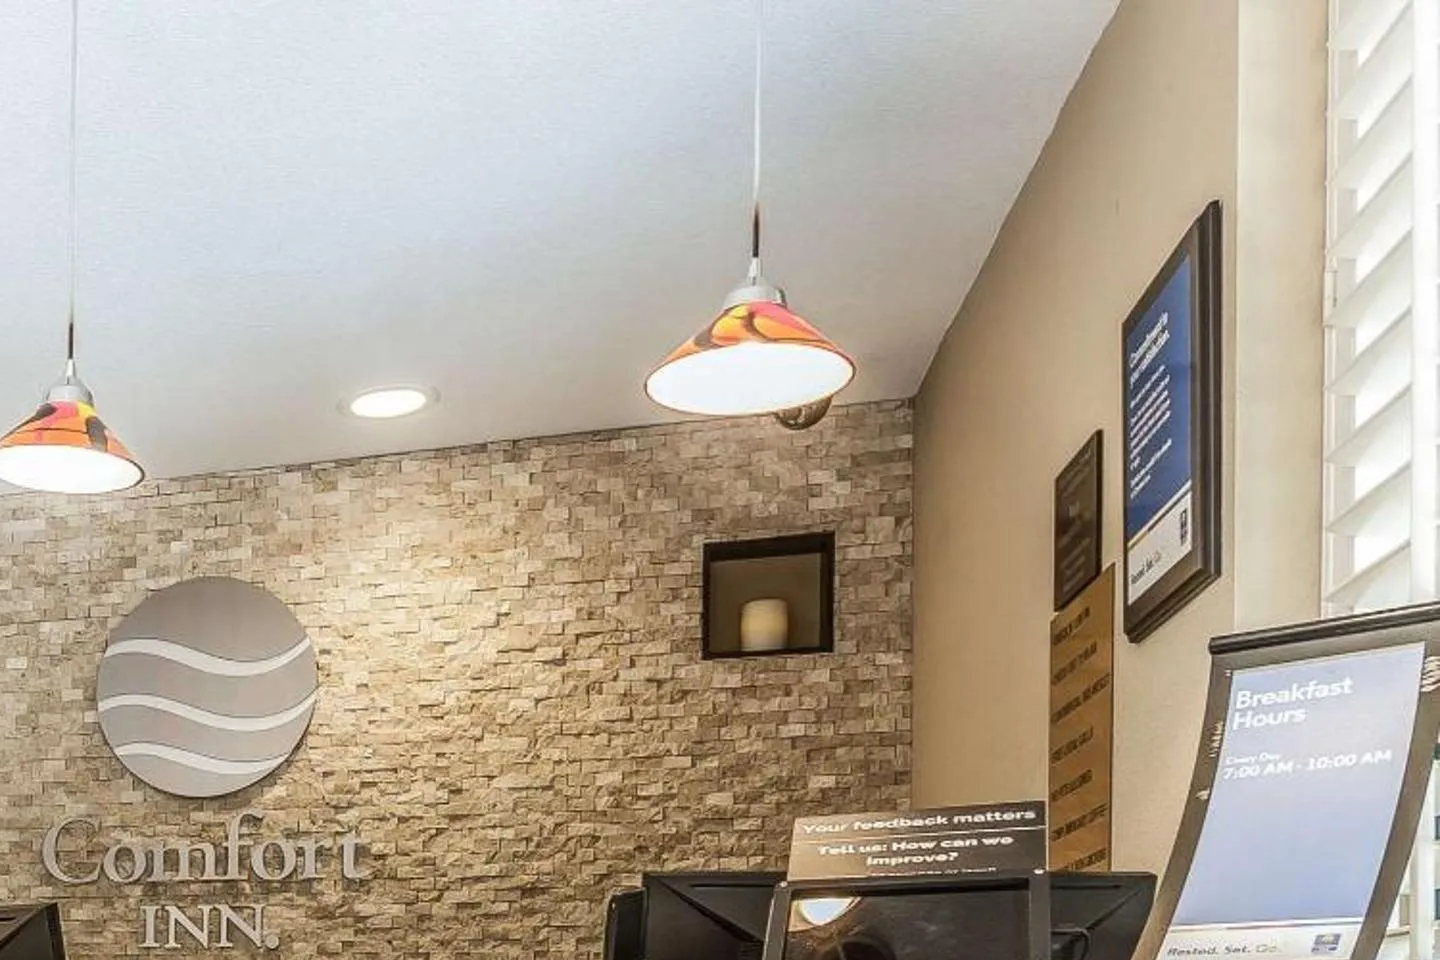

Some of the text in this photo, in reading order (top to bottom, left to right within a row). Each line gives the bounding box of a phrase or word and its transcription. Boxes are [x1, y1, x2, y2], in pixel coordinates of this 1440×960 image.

[1236, 677, 1353, 709] Breakfast
[1232, 707, 1307, 730] Hours
[1222, 764, 1260, 780] 7:00
[1263, 761, 1294, 775] AM
[1307, 753, 1358, 771] 10:00
[1360, 749, 1392, 765] AM
[803, 810, 1036, 835] Your feedback matters
[42, 813, 363, 886] Comfort
[818, 844, 856, 856] Tell
[892, 841, 939, 852] How
[941, 837, 978, 848] can
[981, 835, 1015, 846] we
